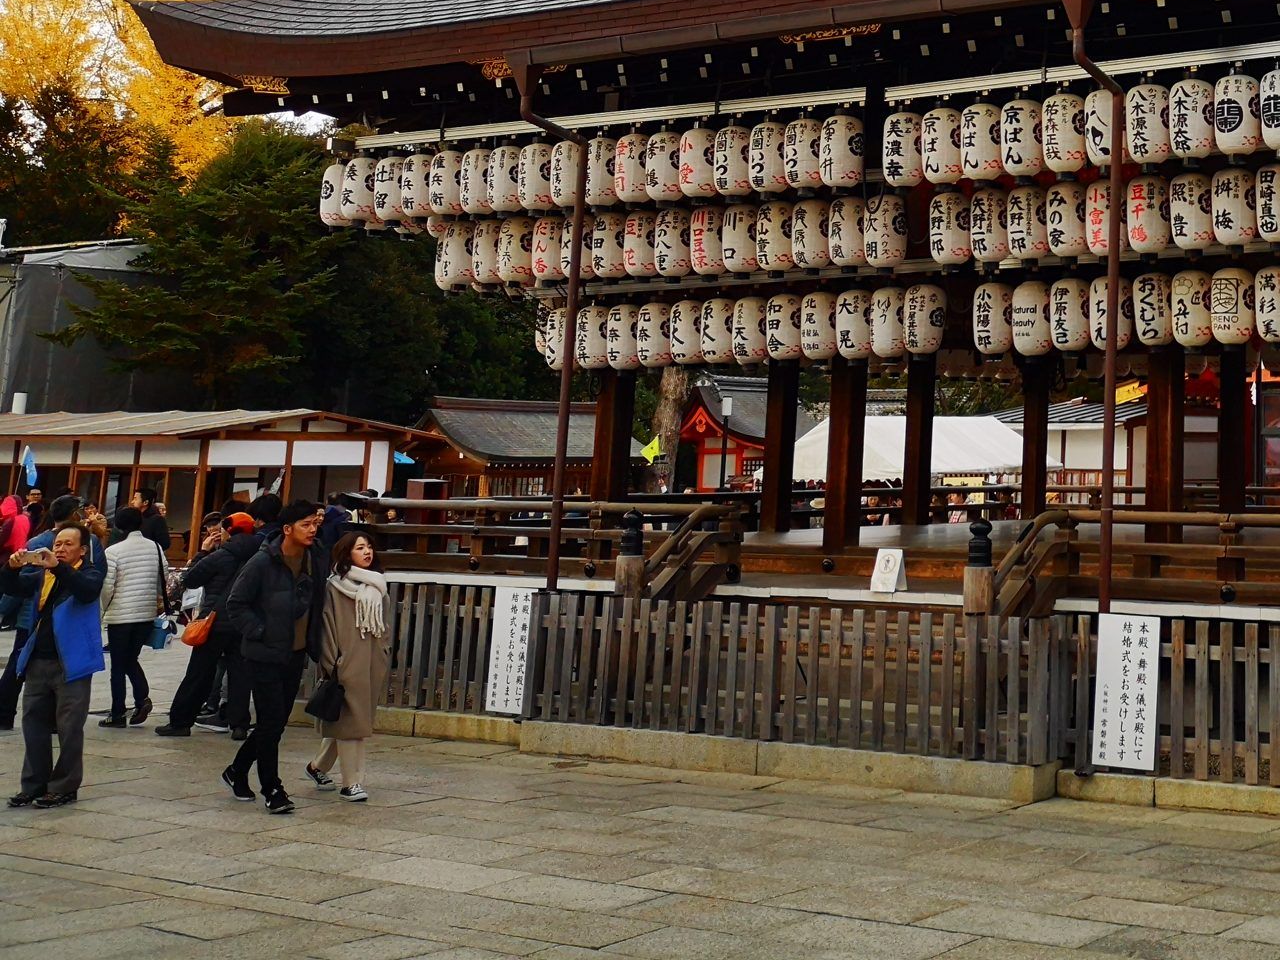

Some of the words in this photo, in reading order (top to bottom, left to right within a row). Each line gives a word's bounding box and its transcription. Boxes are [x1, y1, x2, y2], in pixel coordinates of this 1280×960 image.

[924, 113, 941, 174] 京ばん
[963, 109, 981, 169] 京ばん
[1003, 105, 1024, 166] 京ばん
[1130, 90, 1150, 158] 八木源太郎
[1172, 85, 1192, 153] 八木源太郎
[885, 119, 904, 181] 美濃幸
[374, 164, 389, 210] 辻留
[430, 155, 446, 207] 権兵衛
[1260, 170, 1278, 234] 田崎真也
[592, 217, 607, 270] 池田家
[623, 218, 637, 268] 豆花
[655, 213, 671, 271] 美の八重
[724, 211, 737, 261] 川口
[756, 206, 772, 266] 茂山童司
[930, 199, 945, 256] 矢野一郎
[972, 196, 988, 256] 矢野一郎
[1009, 194, 1027, 254] 矢野一郎
[1049, 191, 1067, 248] みの家
[1088, 188, 1108, 248] 小富美
[608, 309, 621, 362] 元奈古
[638, 308, 651, 362] 元奈古
[804, 298, 817, 325] 北尾
[838, 298, 855, 350] 大晃
[976, 288, 993, 349] 小松陽一郎
[1053, 287, 1070, 345] 伊原友己
[1138, 277, 1158, 339] おくむら
[1259, 273, 1280, 338] 満彩美
[503, 592, 519, 708] 結婚式をお受けします
[514, 592, 531, 708] 本殿・舞殿・儀式殿にて
[1117, 621, 1133, 762] 結婚式をお受けします
[1133, 621, 1150, 761] 本殿・舞殿・儀式殿にて
